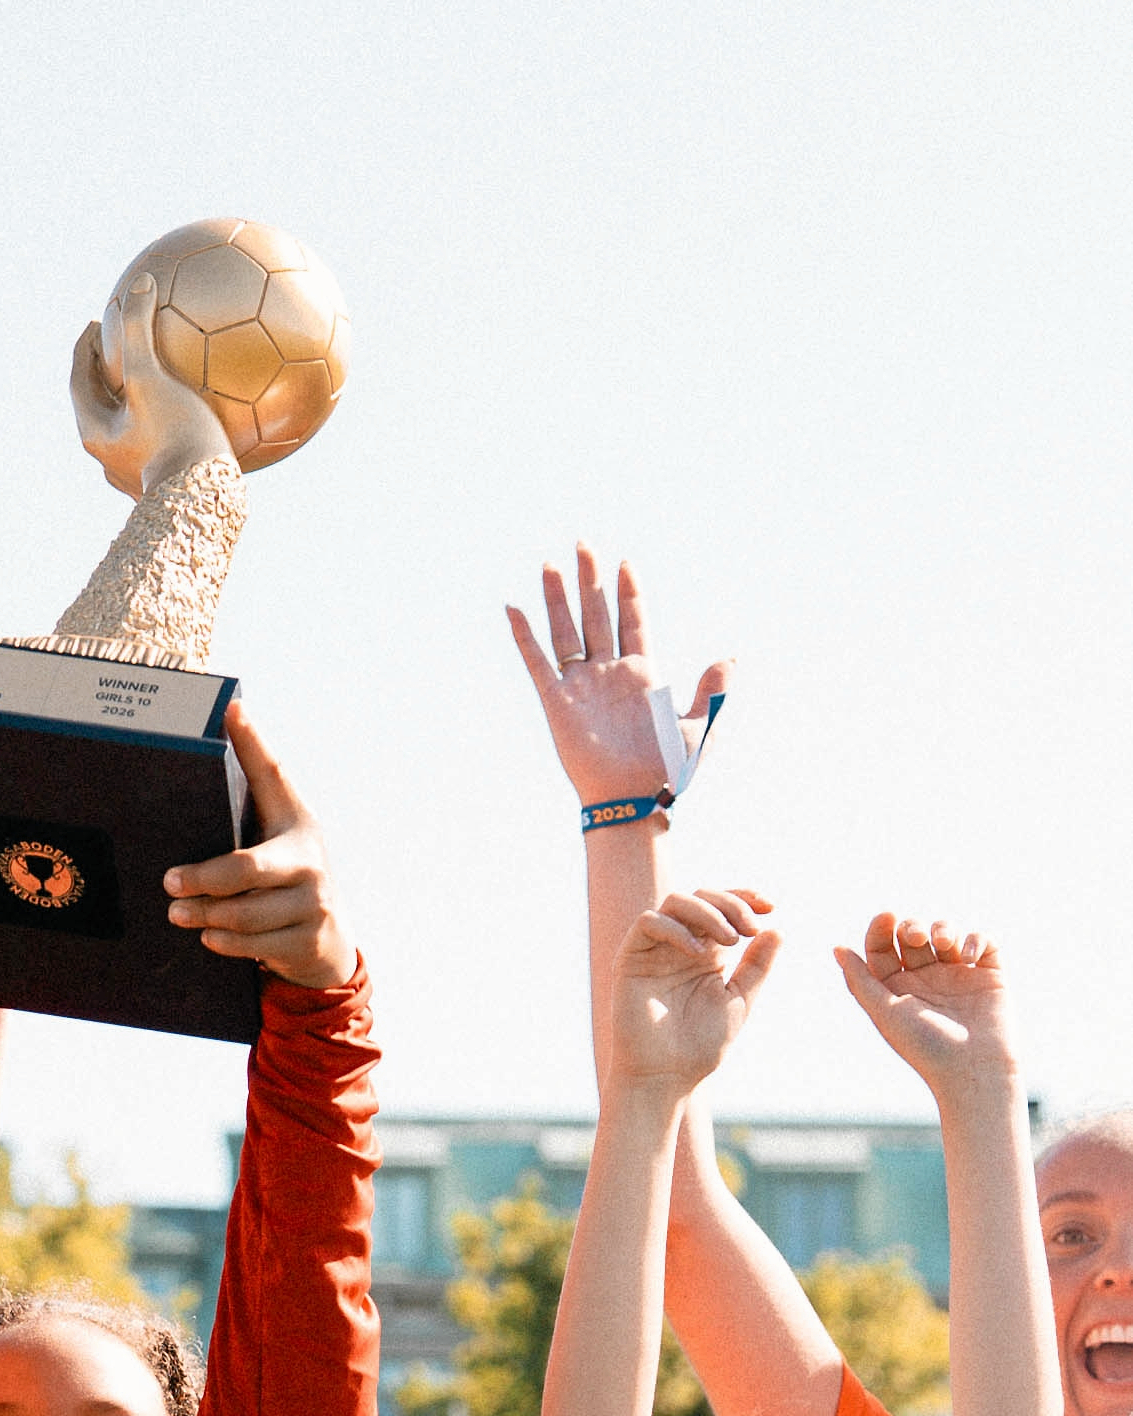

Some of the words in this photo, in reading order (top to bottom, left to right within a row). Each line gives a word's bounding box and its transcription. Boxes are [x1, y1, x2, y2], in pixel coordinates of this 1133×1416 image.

[98, 676, 160, 695] WINNER
[95, 691, 134, 705] GIRLS
[137, 697, 152, 707] 10
[101, 706, 136, 718] 2026
[592, 803, 637, 824] 2026
